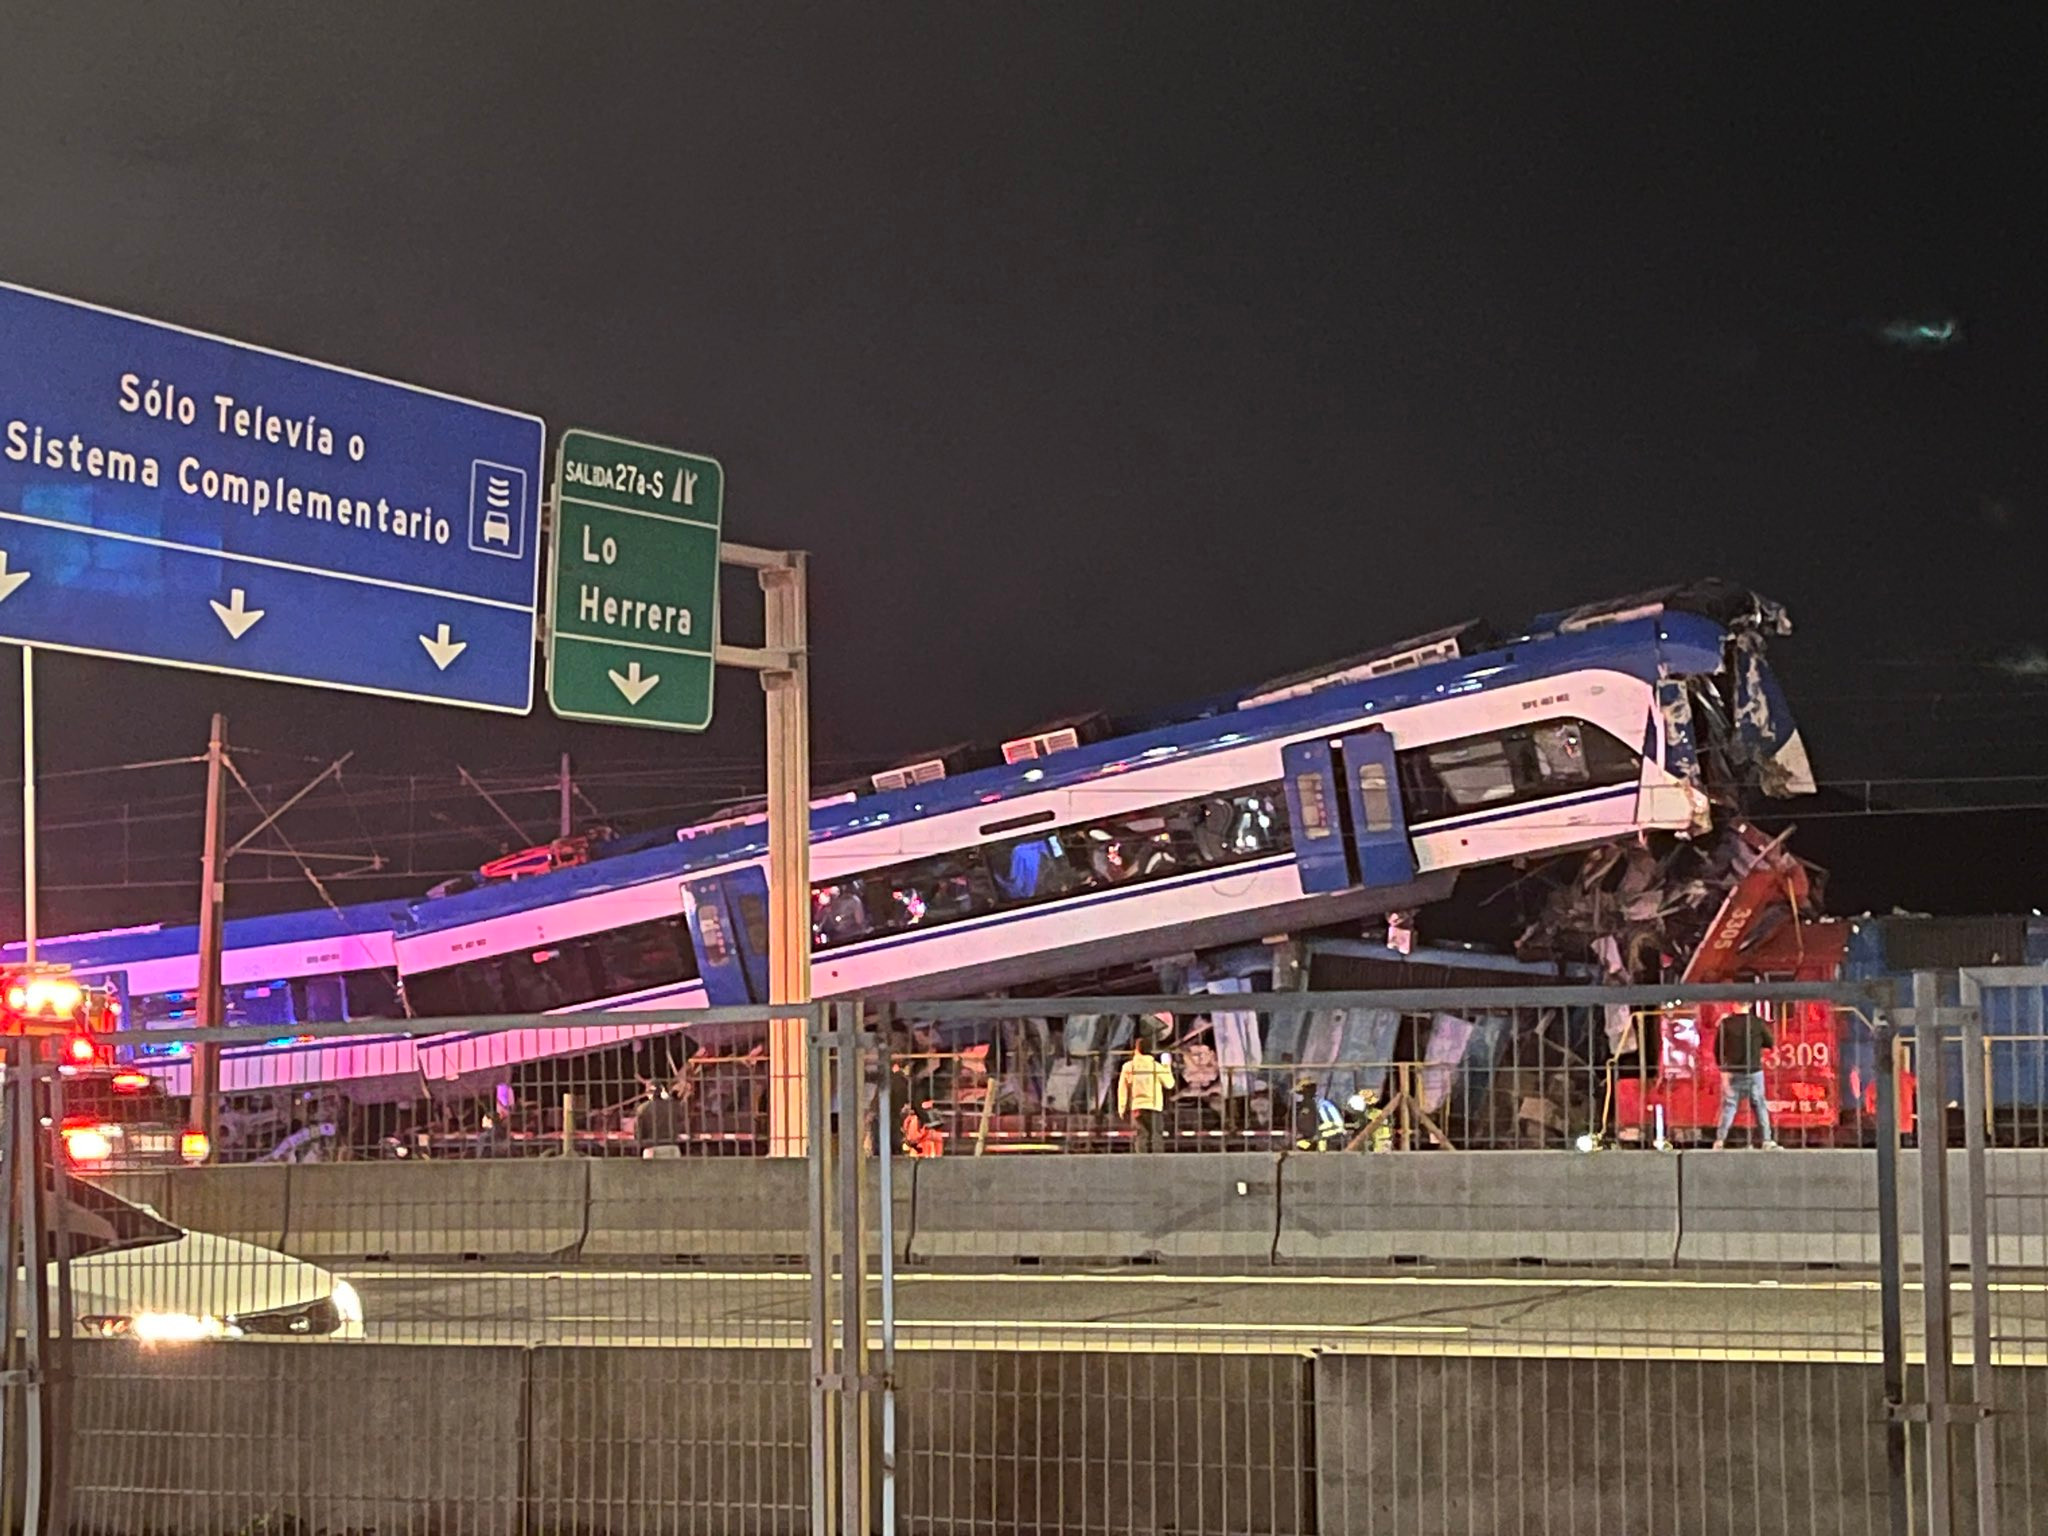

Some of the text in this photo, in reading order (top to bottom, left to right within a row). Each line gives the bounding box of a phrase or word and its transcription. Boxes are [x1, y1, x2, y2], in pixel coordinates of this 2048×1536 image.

[119, 373, 365, 462] Sólo Televía o
[4, 420, 451, 545] Sistema Complementario
[583, 524, 617, 565] Lo
[580, 584, 692, 636] Herrera
[1713, 908, 1752, 949] 3305
[1761, 1042, 1829, 1069] 3309
